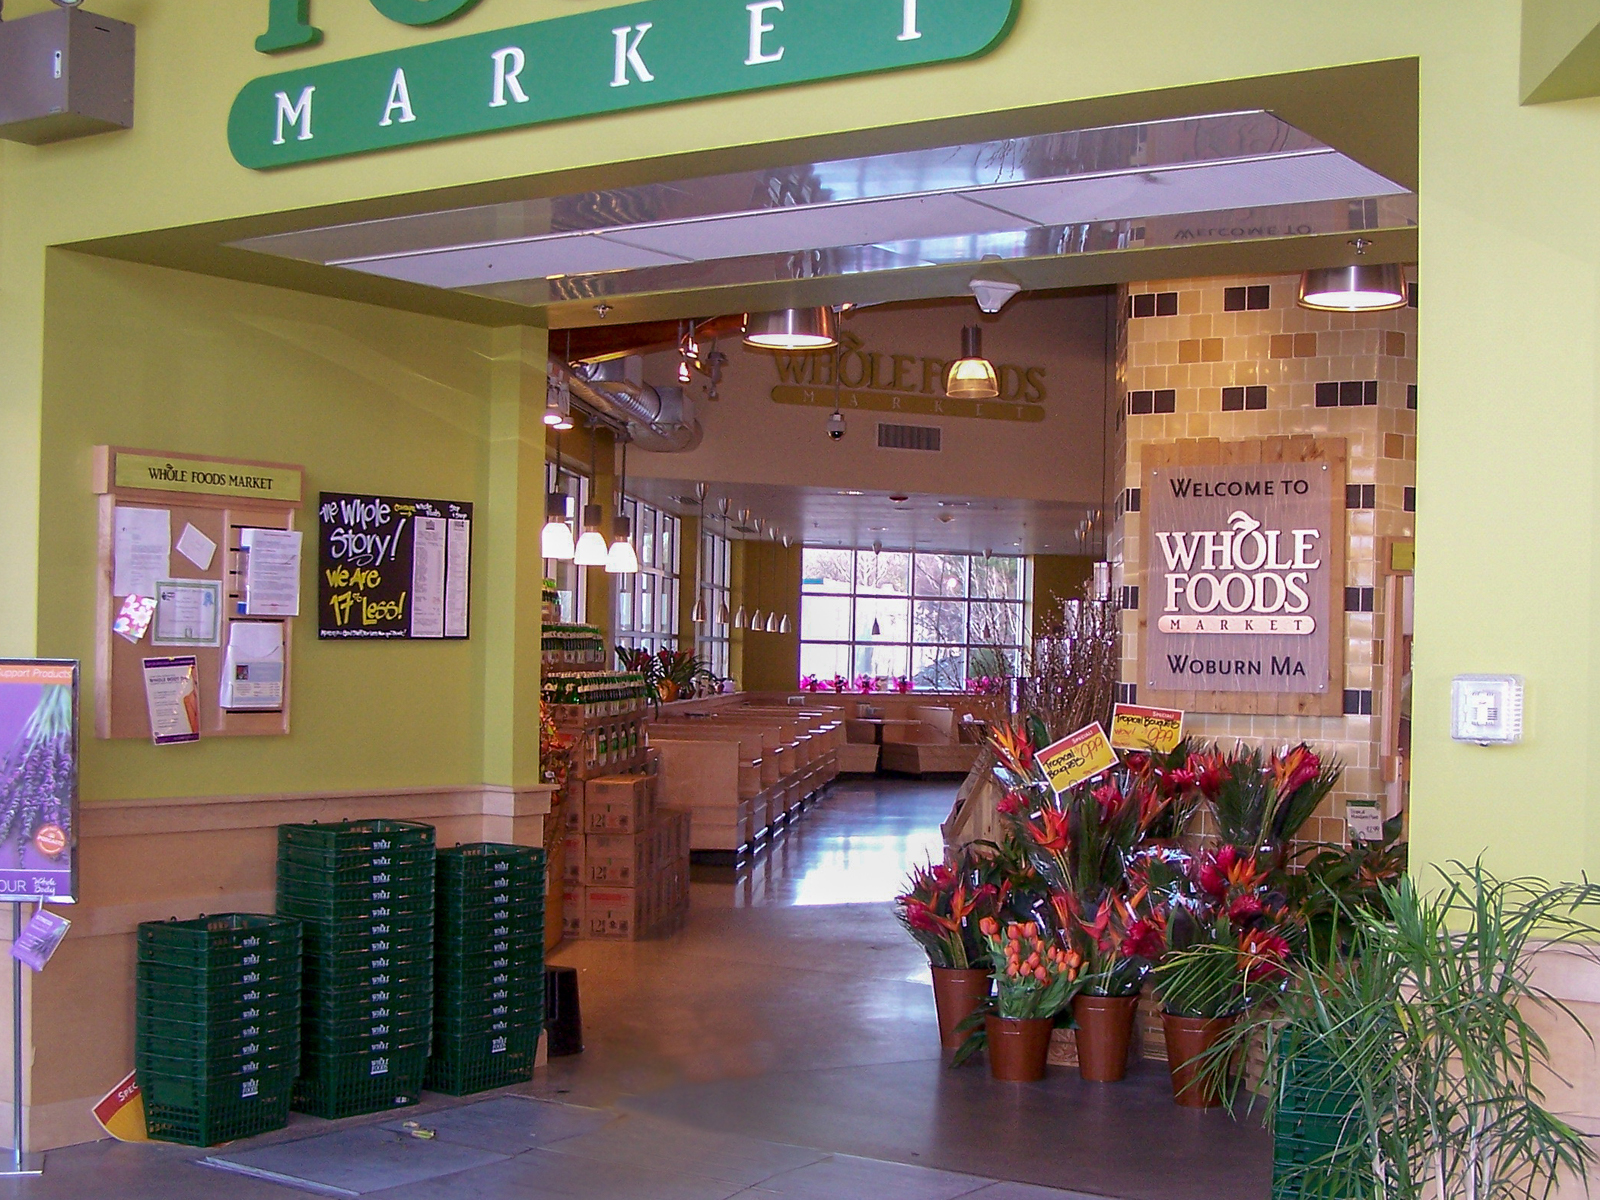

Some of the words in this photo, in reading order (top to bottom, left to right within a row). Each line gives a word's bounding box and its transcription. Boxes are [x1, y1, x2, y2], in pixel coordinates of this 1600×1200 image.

[271, 0, 922, 145] MARKET
[772, 338, 917, 391] WHOLE
[921, 357, 1047, 403] FDS
[148, 464, 188, 483] WHOLE
[191, 470, 226, 486] FOODS
[229, 473, 274, 490] MARKET
[1281, 479, 1310, 495] TO
[340, 498, 391, 530] Whole
[330, 518, 406, 566] Story!
[1155, 512, 1322, 571] WHOLE
[1163, 572, 1310, 614] FOODS
[1170, 619, 1303, 632] MARKET
[0, 668, 29, 679] upport
[1167, 654, 1261, 675] WOBURN
